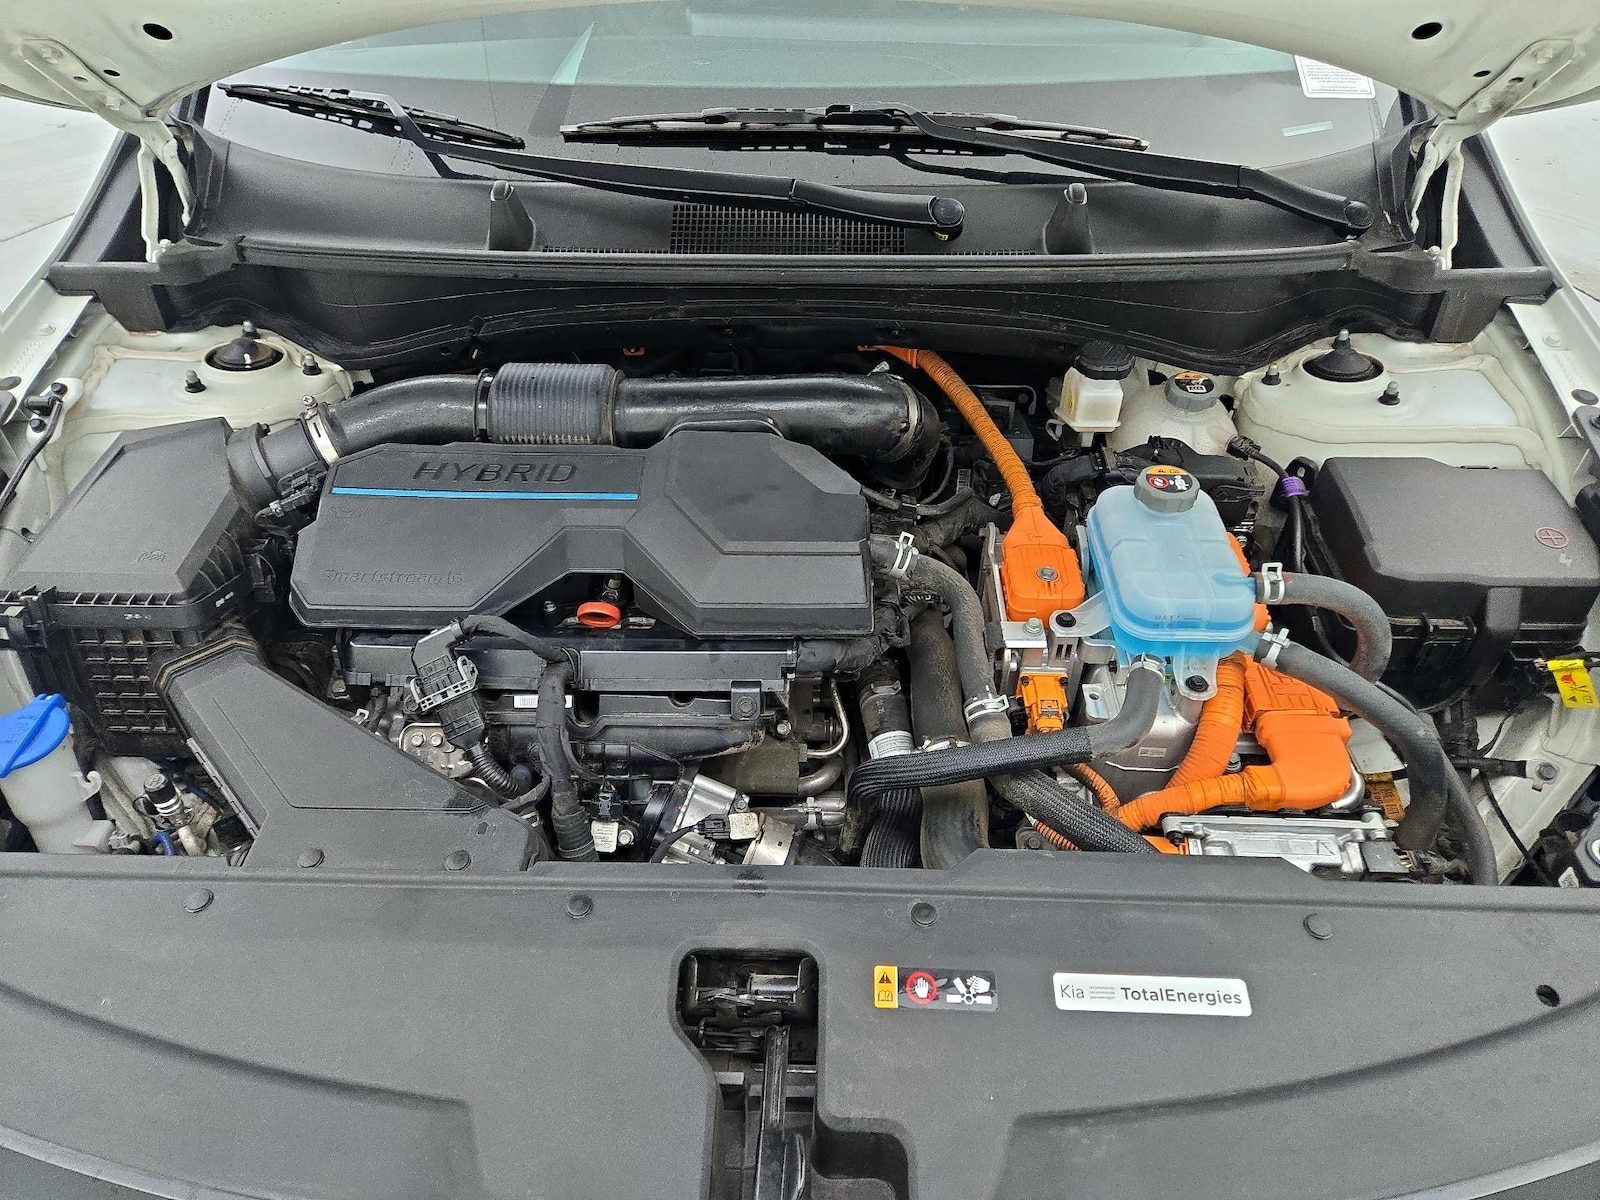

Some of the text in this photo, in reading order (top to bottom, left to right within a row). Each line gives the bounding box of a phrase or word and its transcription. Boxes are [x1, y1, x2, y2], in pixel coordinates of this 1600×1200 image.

[411, 461, 578, 485] HYBRID
[322, 568, 443, 586] Smartstream
[1060, 984, 1085, 1001] Kia
[1120, 986, 1242, 1006] TotalEnergies
